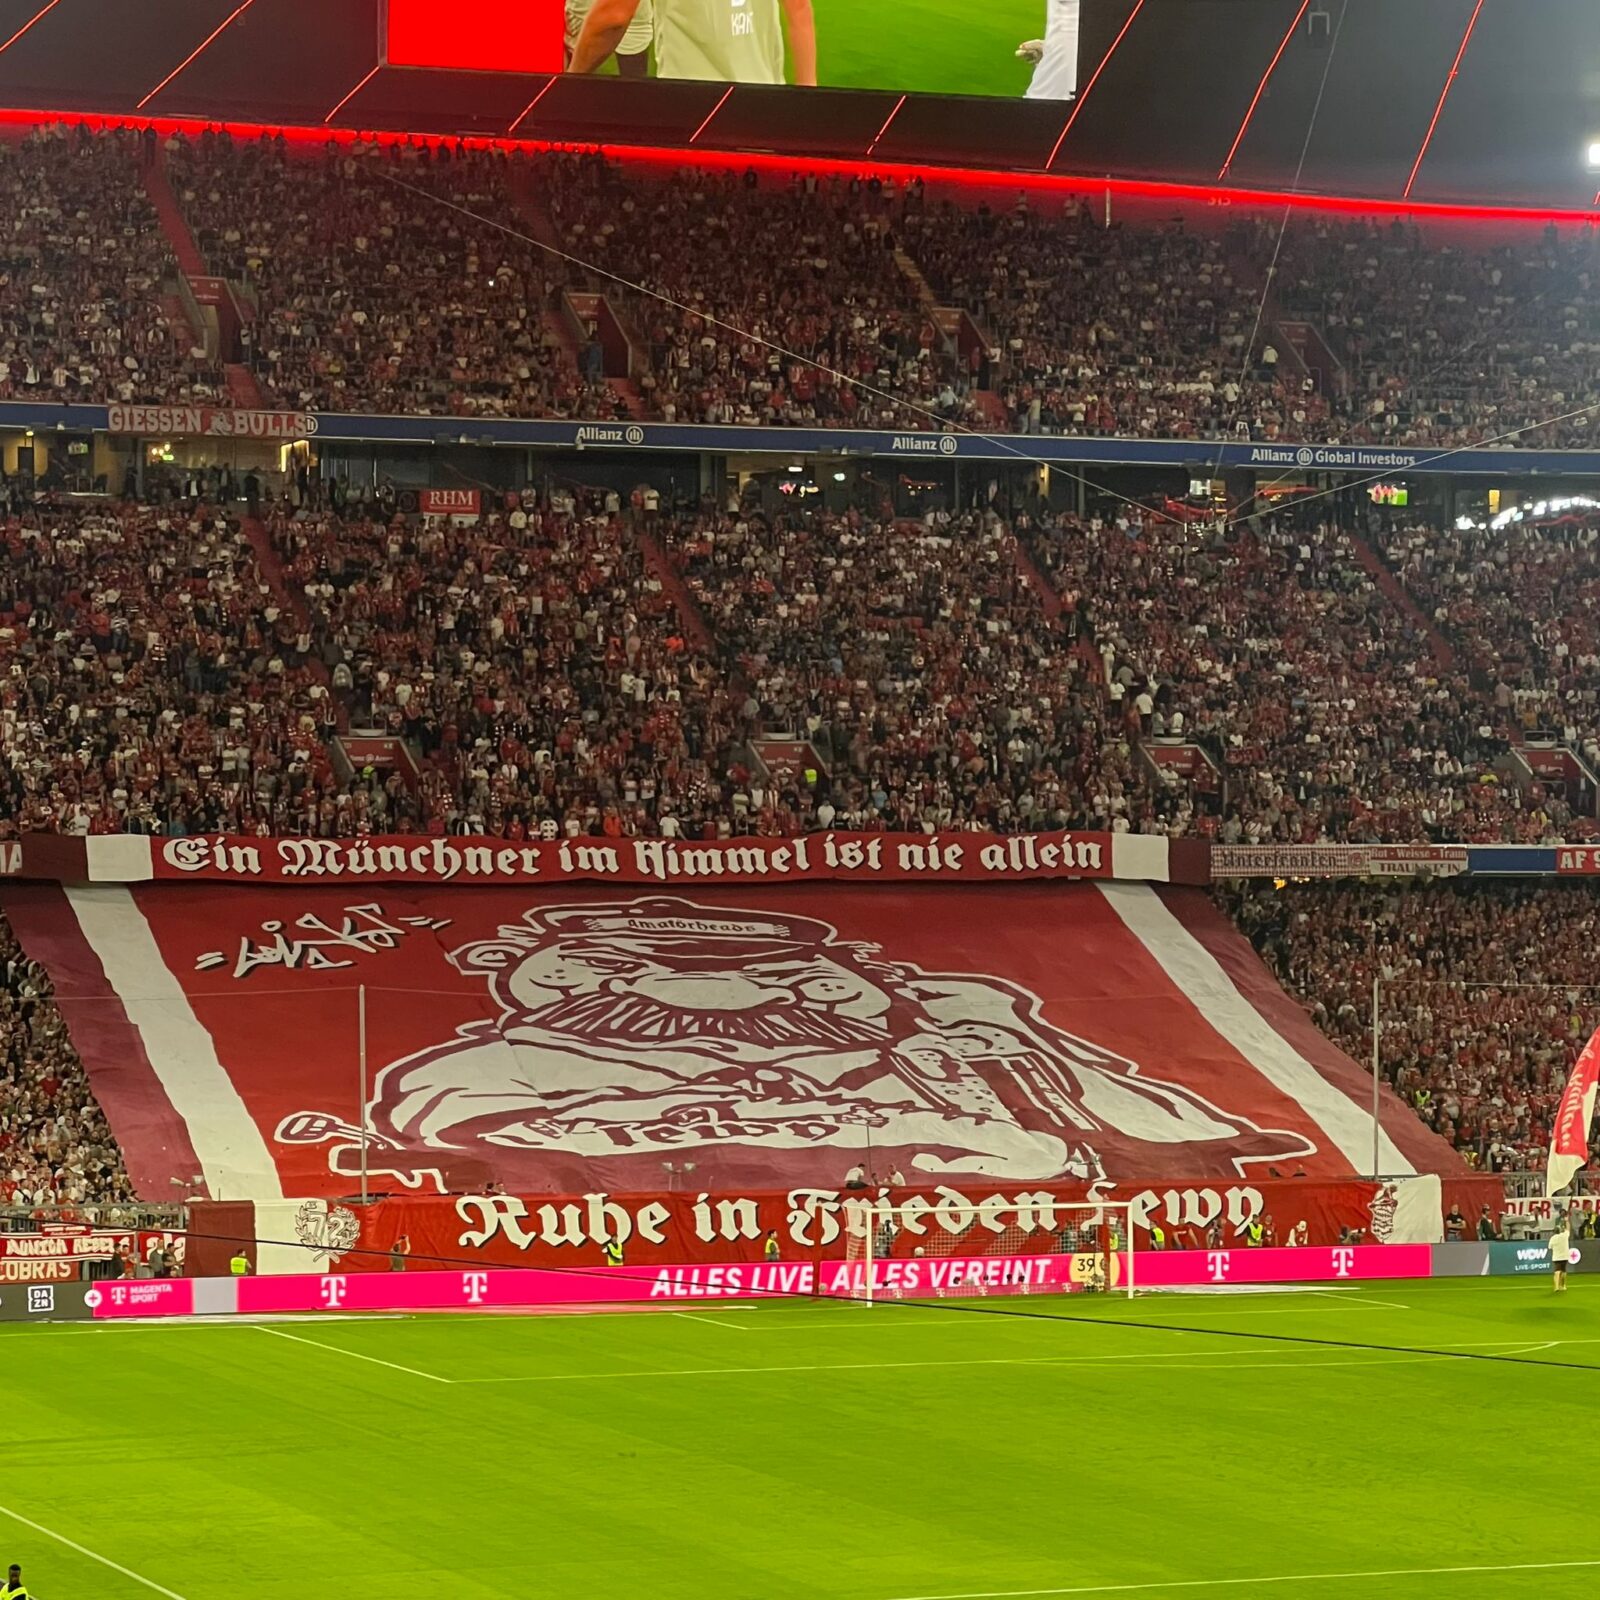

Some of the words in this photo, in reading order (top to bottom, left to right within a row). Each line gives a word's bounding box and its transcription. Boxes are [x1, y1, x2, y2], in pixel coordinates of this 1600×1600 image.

[108, 406, 202, 433] GIESSEN
[233, 411, 307, 437] BULLS
[577, 427, 623, 441] Allianz
[892, 437, 937, 451] Allianz
[1251, 448, 1294, 462] Allianz
[1315, 450, 1355, 464] Global
[1358, 451, 1415, 466] Investors
[430, 490, 473, 505] RHM
[163, 837, 262, 874] Ein
[278, 837, 540, 880] Münchner
[560, 839, 618, 874] im
[634, 837, 809, 879] Himmel
[824, 833, 882, 872] ist
[899, 836, 963, 872] nie
[980, 834, 1104, 871] allein
[1560, 850, 1588, 869] AF
[1378, 862, 1461, 873] TRAUNSTIN
[455, 1192, 672, 1251] Ruhe
[692, 1192, 762, 1243] in
[787, 1185, 1060, 1247] Frieden
[650, 1268, 743, 1296] ALLES
[751, 1265, 814, 1293] LIVE
[831, 1263, 921, 1292] ALLES
[929, 1258, 1056, 1289] VEREINT.
[33, 1290, 48, 1298] DA
[130, 1284, 173, 1295] MAGENTA
[34, 1299, 49, 1308] ZN
[130, 1293, 158, 1304] SPORT
